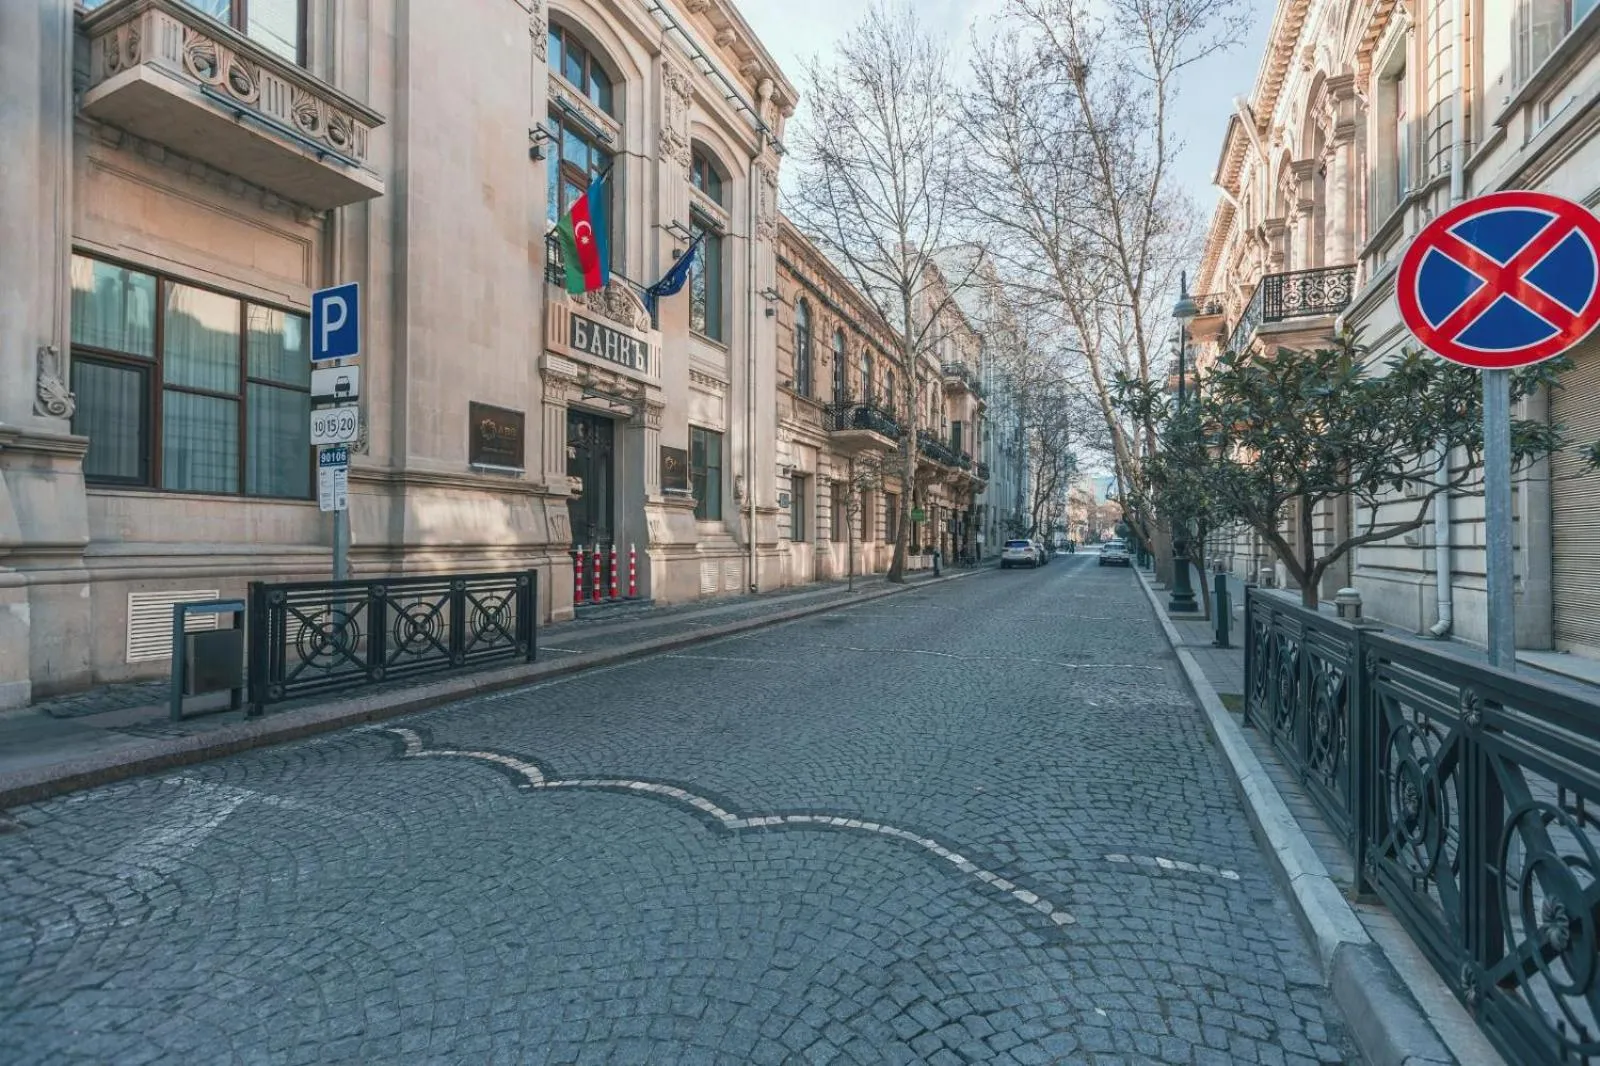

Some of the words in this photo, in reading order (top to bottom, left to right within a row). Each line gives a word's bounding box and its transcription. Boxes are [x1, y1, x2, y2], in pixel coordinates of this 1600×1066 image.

[321, 295, 348, 352] P
[574, 316, 644, 370] БАНКЪ
[315, 421, 323, 432] 10
[327, 419, 337, 432] 15
[340, 418, 353, 431] 20
[320, 451, 347, 463] 90106
